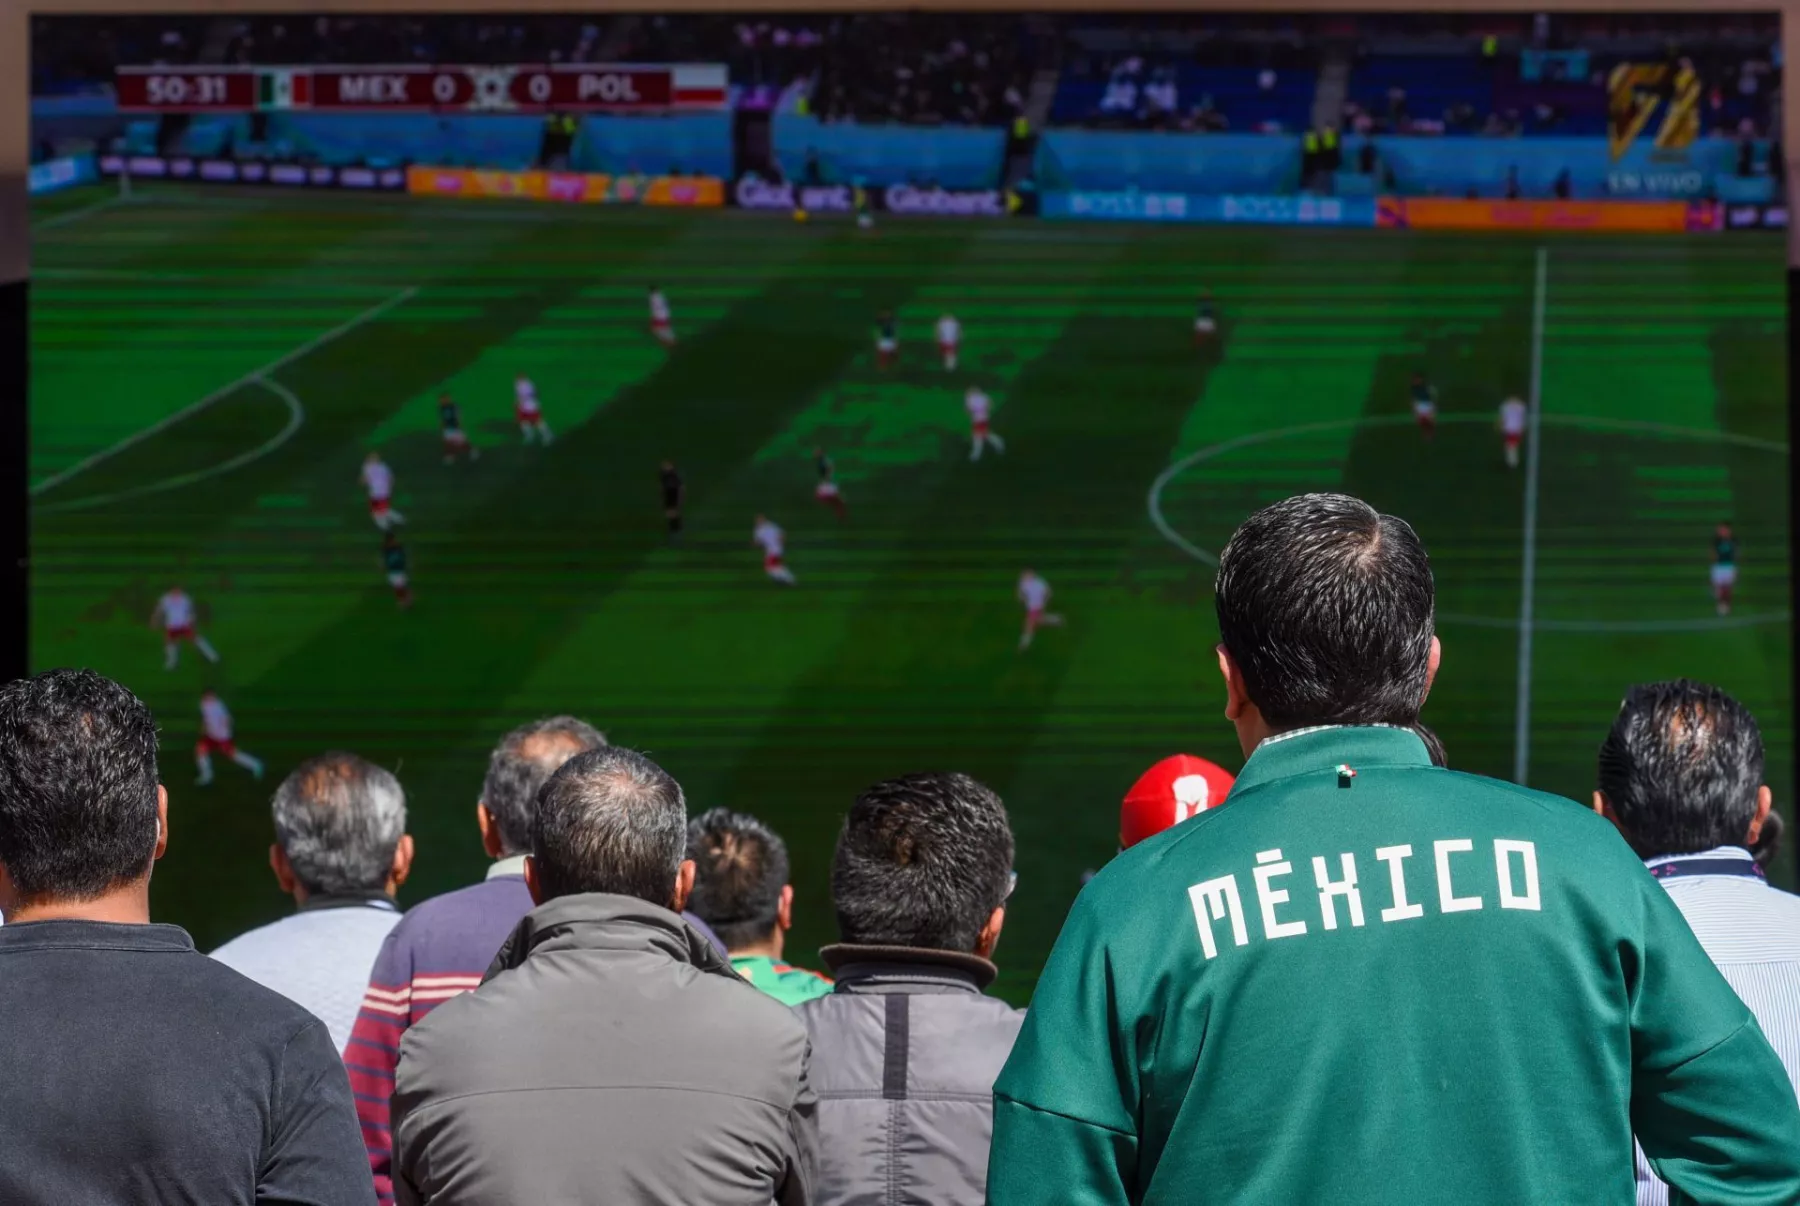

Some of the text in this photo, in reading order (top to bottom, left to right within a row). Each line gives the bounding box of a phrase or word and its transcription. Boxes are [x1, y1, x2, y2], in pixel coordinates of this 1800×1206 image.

[146, 73, 641, 103] 50:31 MEX 0 0 POL
[1187, 838, 1541, 960] MÉXICO
